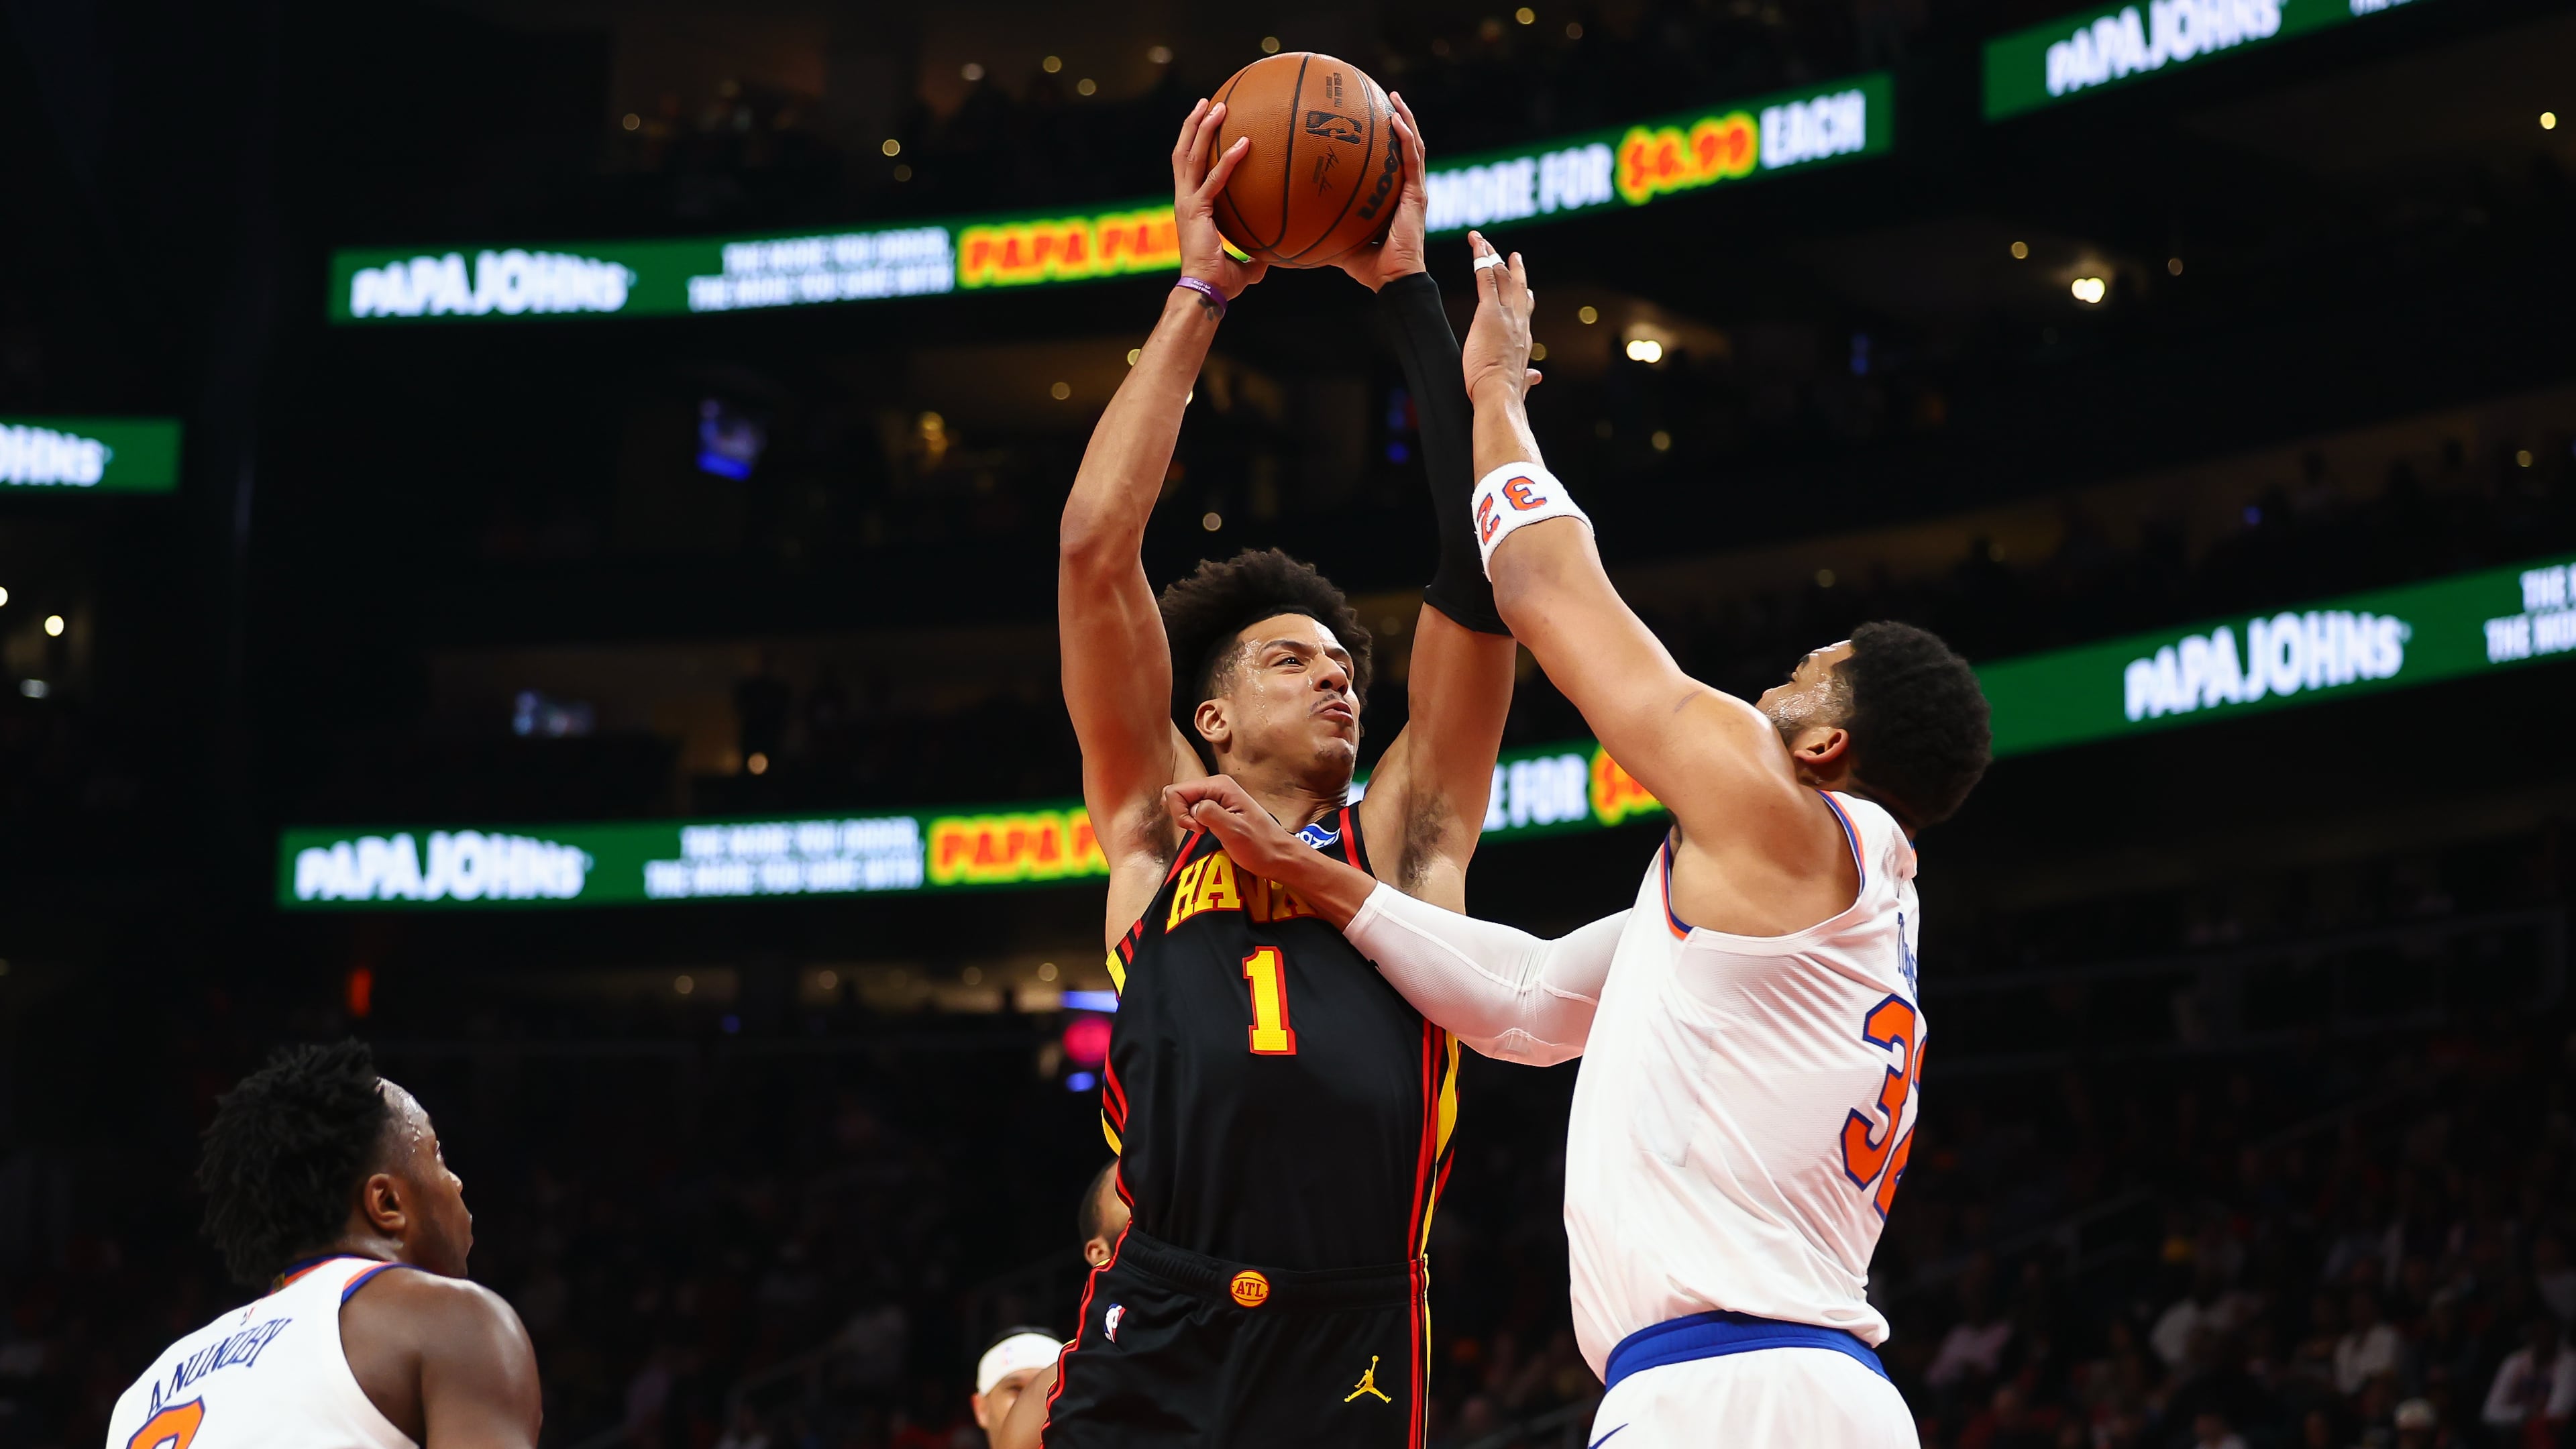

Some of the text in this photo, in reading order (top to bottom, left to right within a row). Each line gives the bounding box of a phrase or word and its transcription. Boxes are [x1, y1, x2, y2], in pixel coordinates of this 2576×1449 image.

[1426, 156, 1538, 233] MORE
[1539, 142, 1613, 214] FOR
[1615, 110, 1759, 206] $6.99
[1759, 88, 1866, 169] EACH
[957, 216, 1091, 288] PAPA
[1509, 753, 1589, 828] FOR
[926, 809, 1061, 886] PAPA
[1242, 946, 1297, 1055] 1
[1235, 1282, 1264, 1299] ATL
[146, 1318, 293, 1422] ANUNOBY
